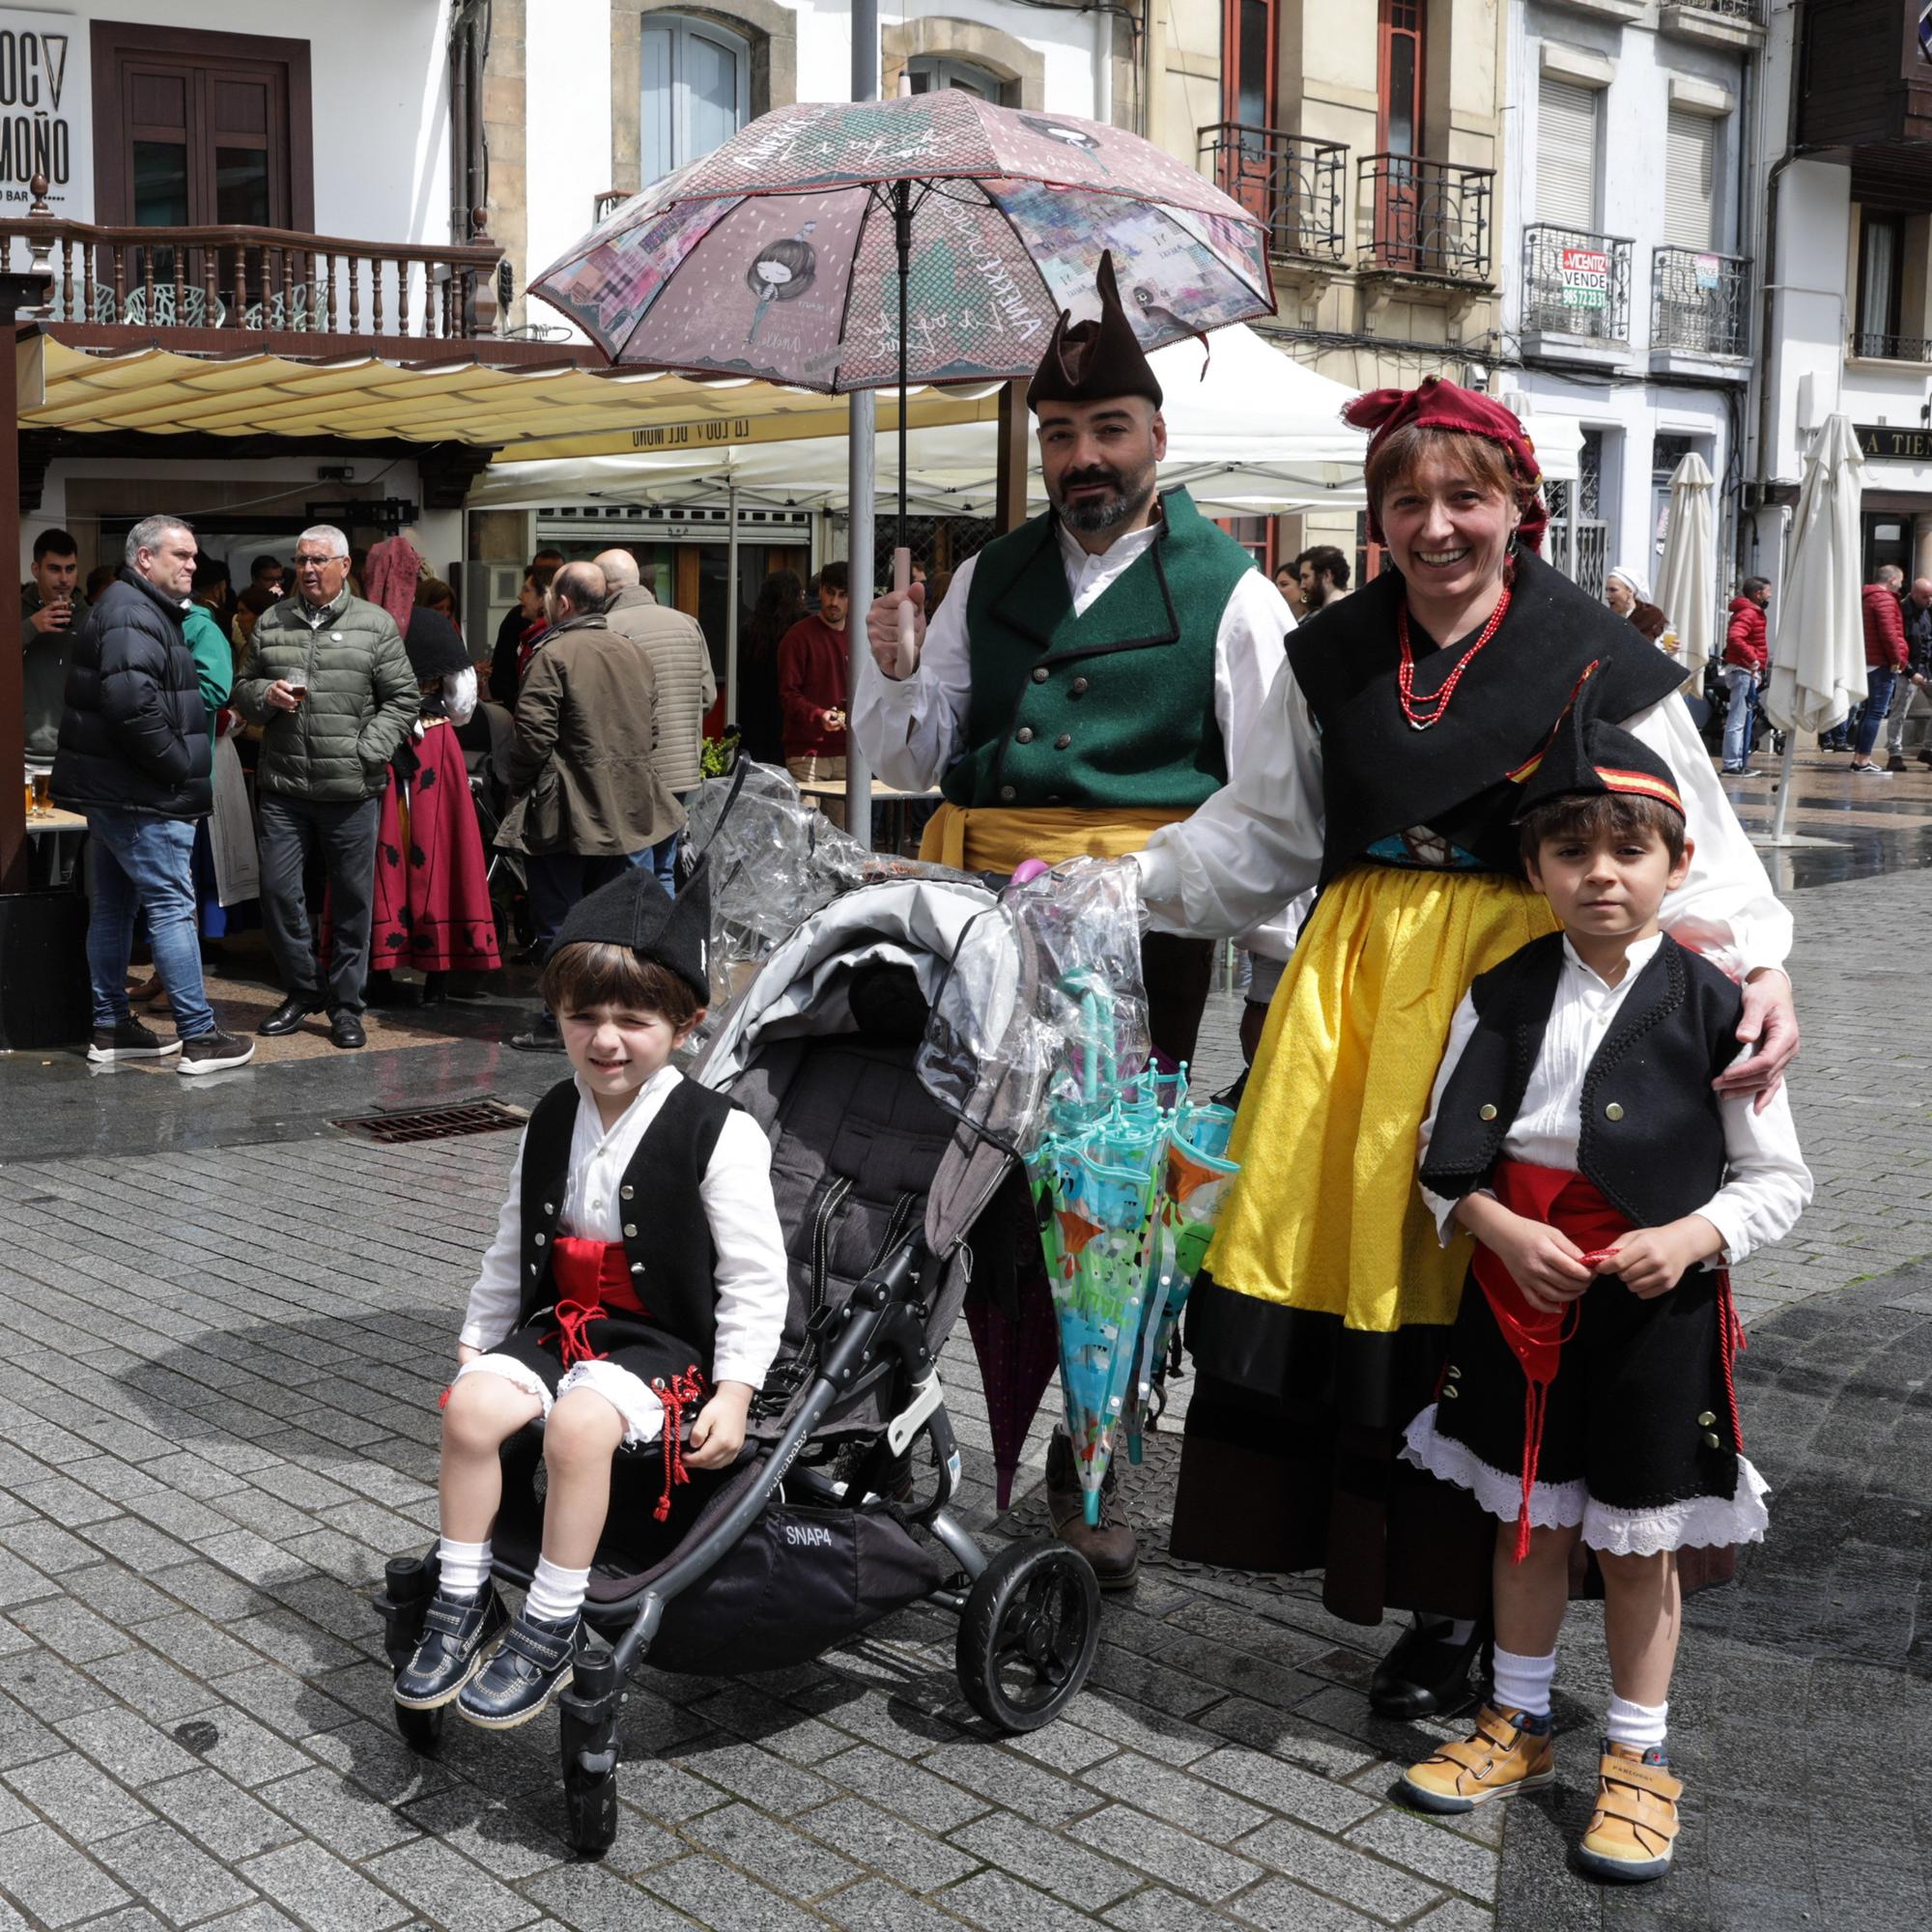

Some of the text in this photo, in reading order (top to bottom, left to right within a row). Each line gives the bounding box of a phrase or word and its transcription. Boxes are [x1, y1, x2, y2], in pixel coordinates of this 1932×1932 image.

[733, 117, 818, 171] ANEKKE
[6, 190, 28, 202] BAR
[1564, 270, 1605, 289] VENDE
[1563, 289, 1577, 304] 985
[1578, 291, 1588, 305] 72
[1588, 292, 1597, 306] 23
[785, 1524, 833, 1547] SNAP4
